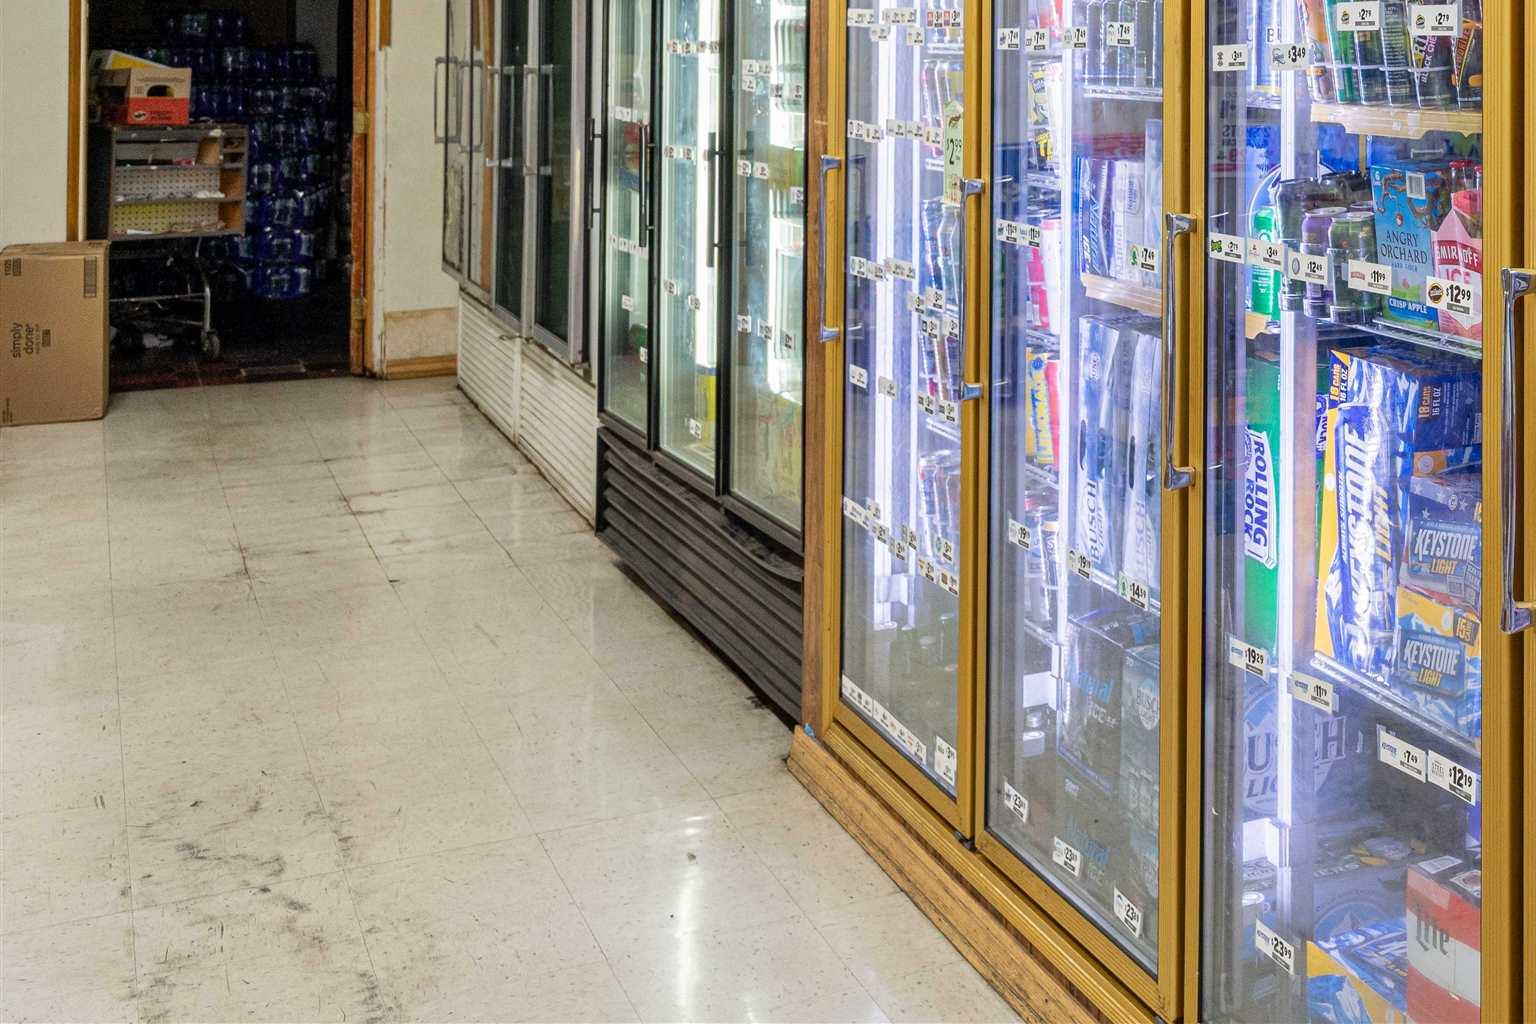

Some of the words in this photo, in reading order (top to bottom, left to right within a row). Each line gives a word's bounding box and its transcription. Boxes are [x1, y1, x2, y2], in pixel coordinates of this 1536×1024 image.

[1358, 7, 1372, 21] $279
[1435, 12, 1449, 26] $279
[1117, 24, 1130, 38] $749
[1287, 46, 1306, 63] $349
[1385, 231, 1419, 247] ANGRY
[1141, 248, 1155, 262] $749
[1380, 245, 1428, 265] ORCHARD
[1307, 261, 1323, 274] $1249
[1370, 269, 1386, 284] $1199
[1446, 283, 1472, 304] $1299
[1389, 298, 1407, 311] CRISP
[1408, 301, 1428, 315] APPLE
[24, 326, 36, 355] done
[1254, 440, 1268, 549] ROLLING
[1244, 475, 1255, 539] ROCK
[1087, 482, 1099, 560] BUSCH
[1415, 528, 1479, 561] KEYSTONE
[1432, 559, 1457, 574] LIGHT
[1245, 648, 1264, 665] $1929
[1404, 639, 1460, 673] KEYSTONE
[1417, 668, 1443, 687] LIGHT
[1314, 684, 1327, 698] $1179
[1403, 750, 1418, 764] $749
[1449, 766, 1473, 788] $1219
[1414, 914, 1450, 957] Lite
[1271, 939, 1292, 961] $2399
